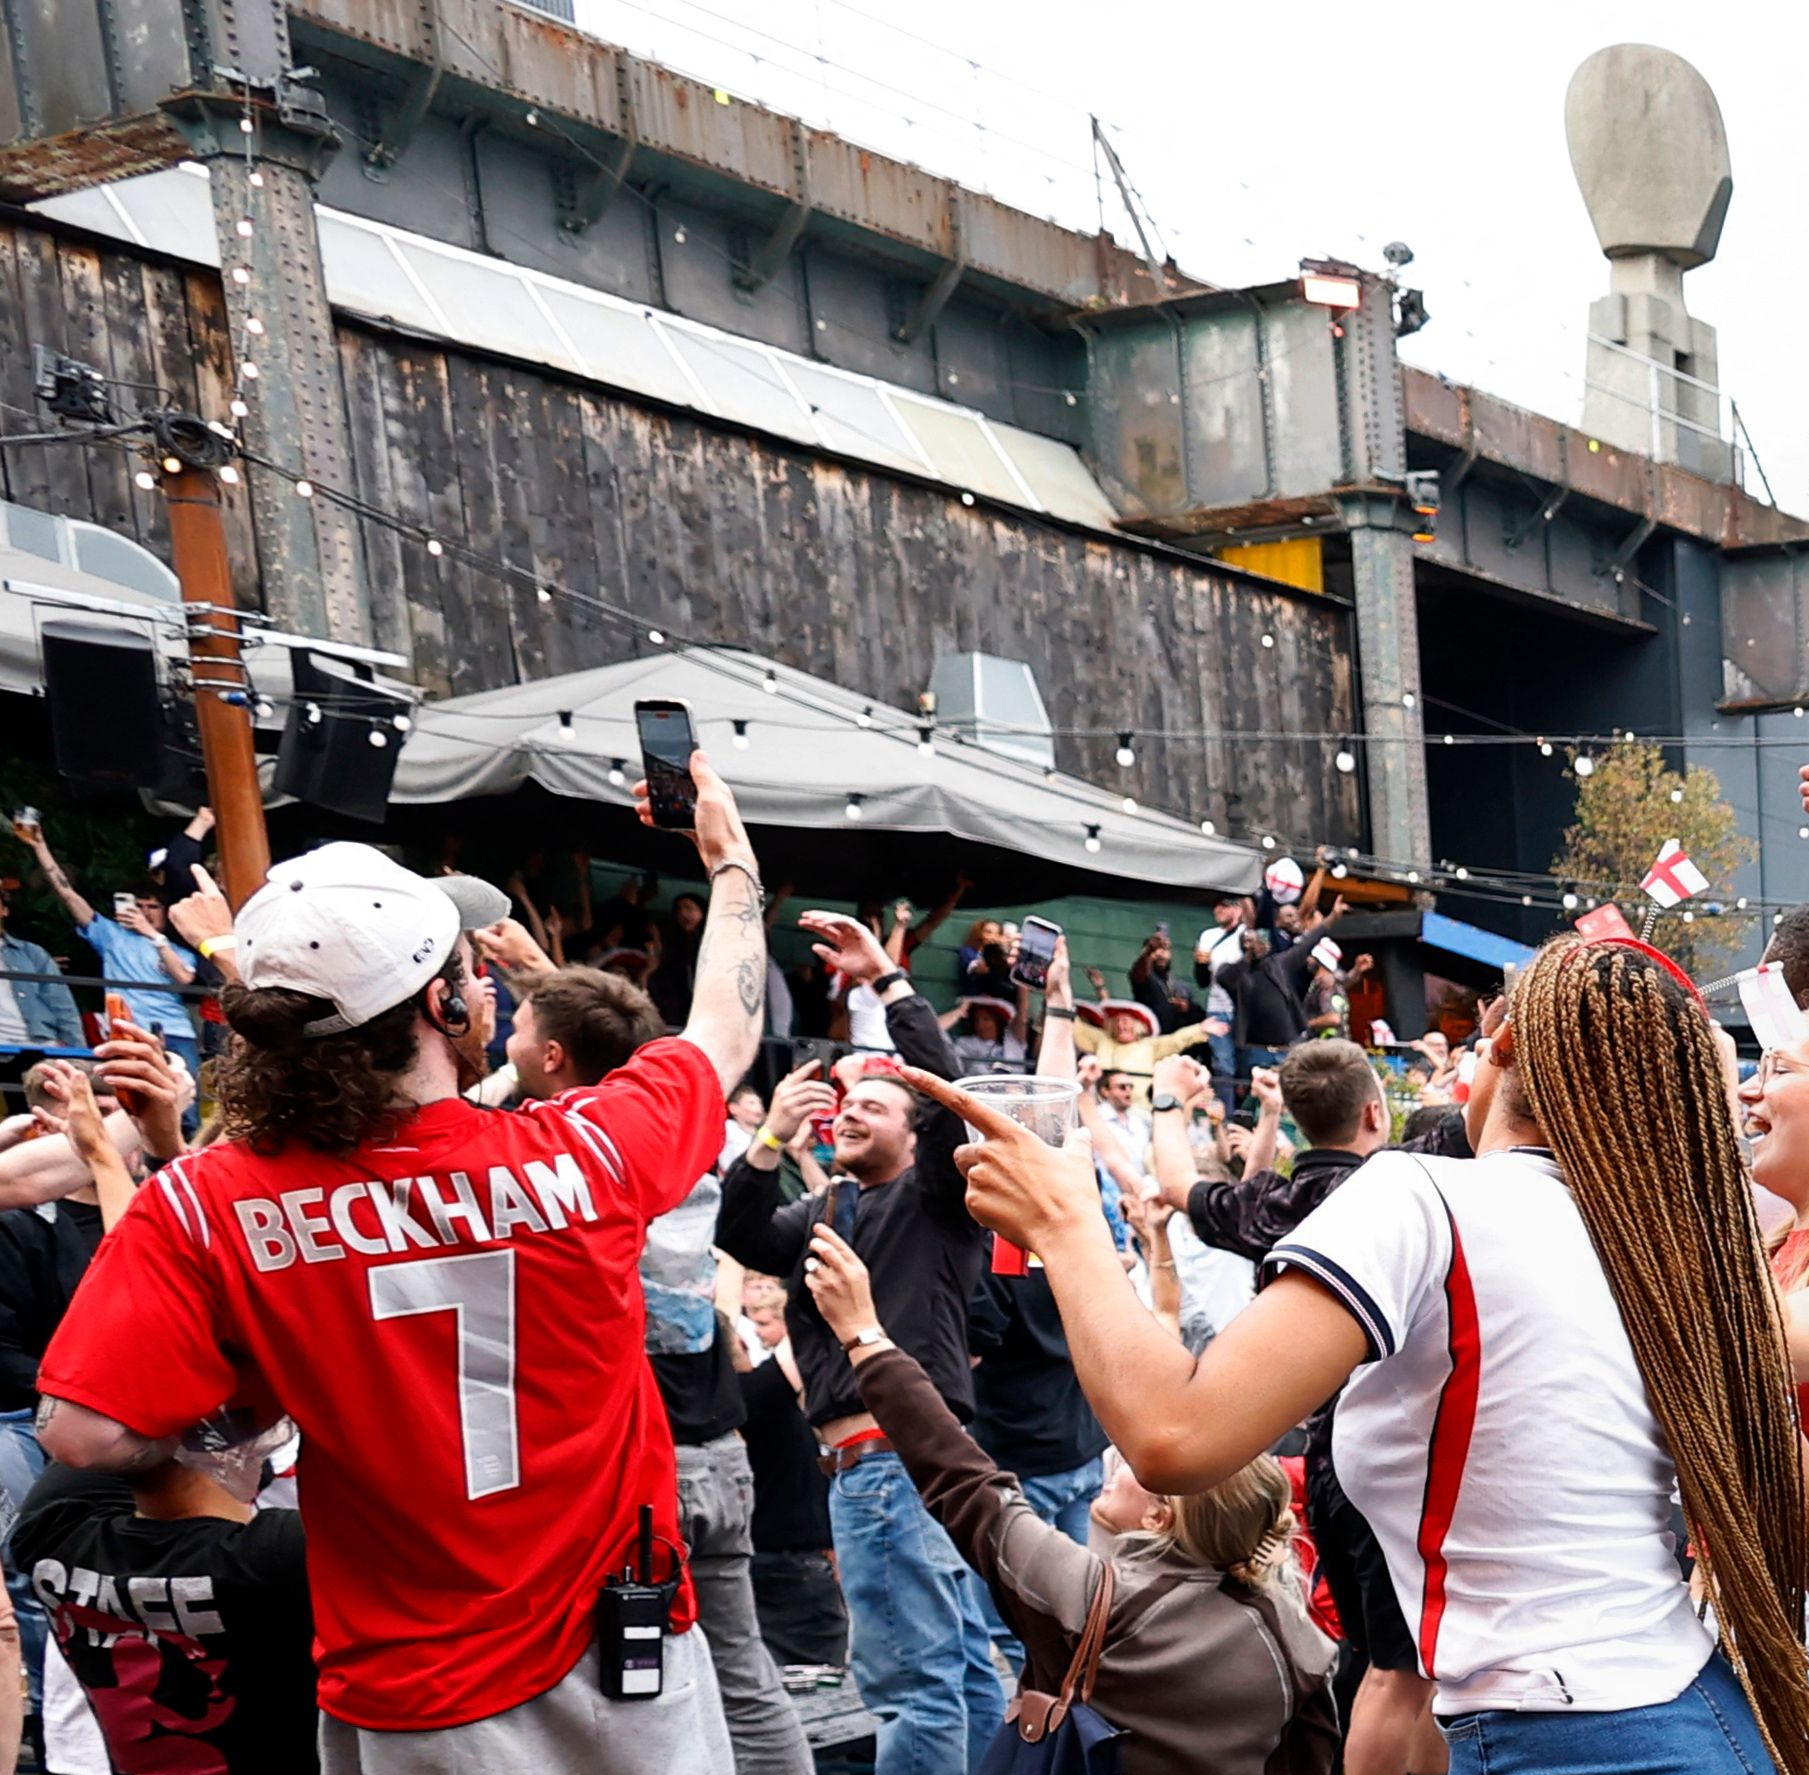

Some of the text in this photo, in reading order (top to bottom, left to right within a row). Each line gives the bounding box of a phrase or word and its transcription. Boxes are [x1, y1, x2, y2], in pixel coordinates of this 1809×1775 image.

[232, 1154, 598, 1273] BECKHAM
[367, 1247, 522, 1501] 7
[32, 1557, 227, 1651] STAFF
